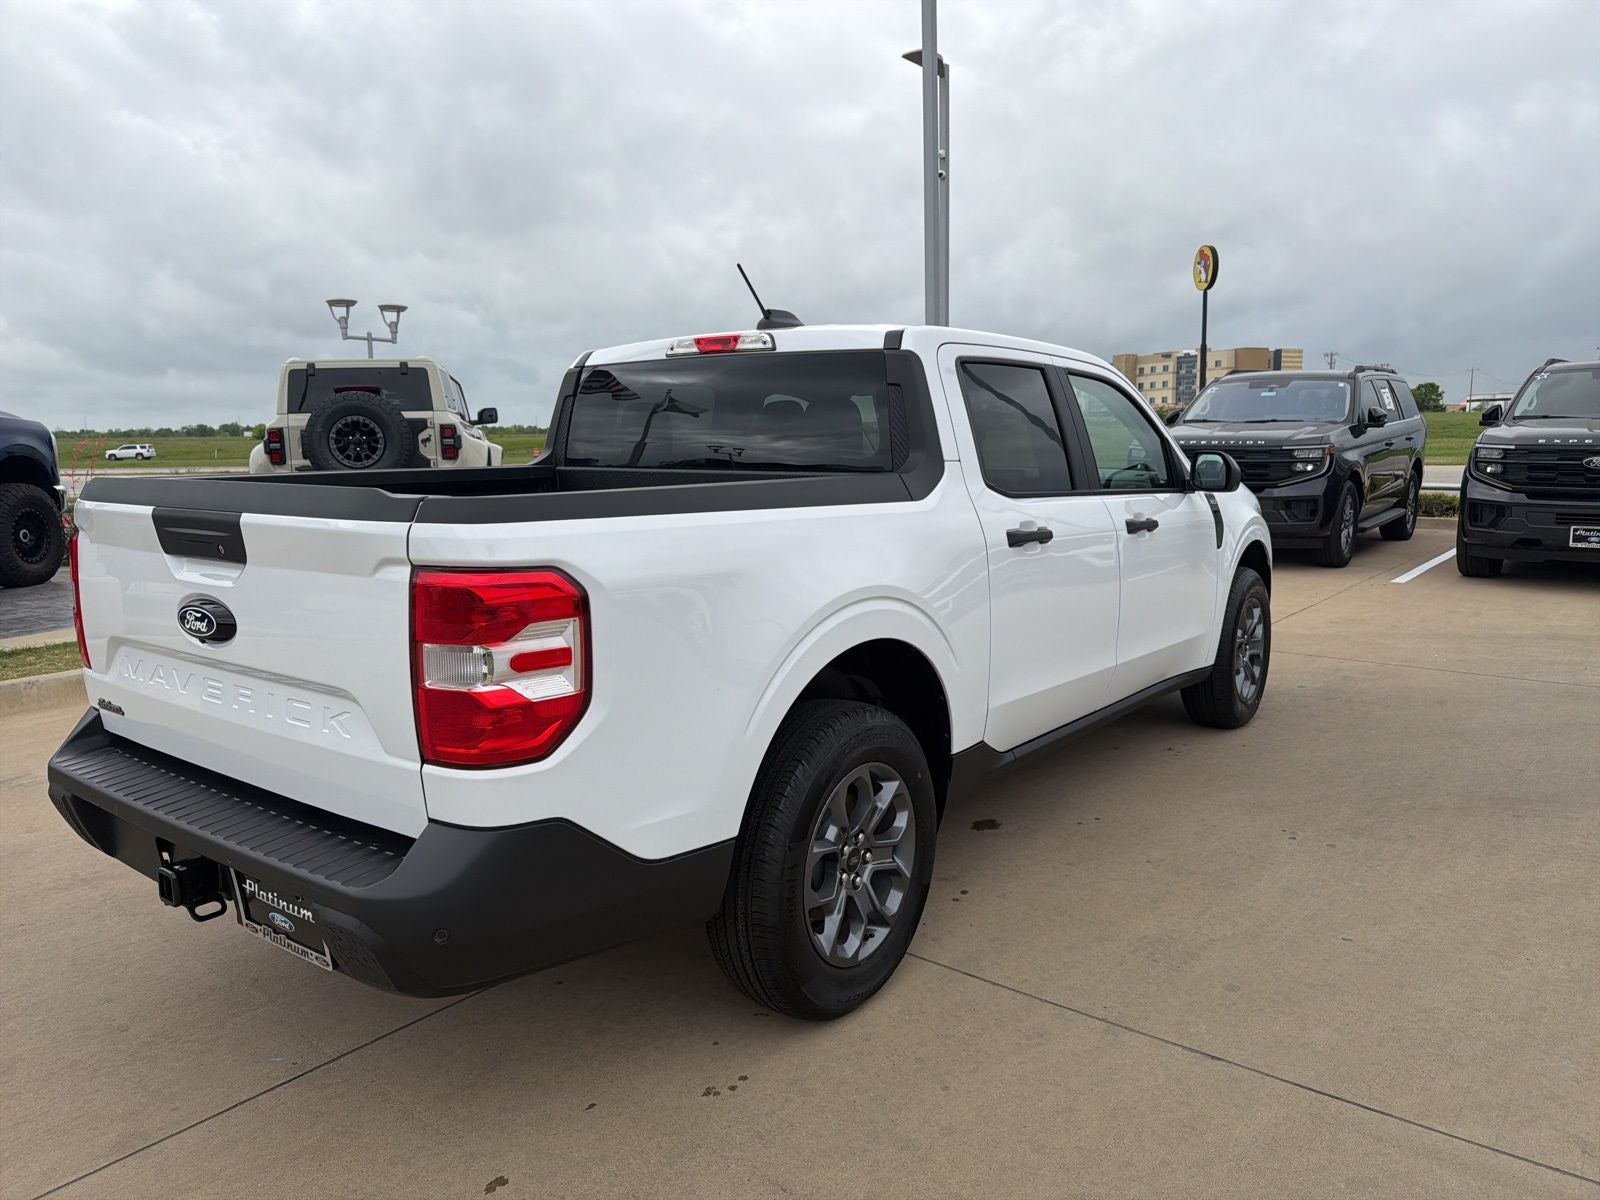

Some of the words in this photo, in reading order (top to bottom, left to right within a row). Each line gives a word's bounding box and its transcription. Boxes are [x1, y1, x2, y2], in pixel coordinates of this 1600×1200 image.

[184, 610, 208, 632] Ford
[122, 654, 352, 739] MAVERICK
[242, 879, 316, 924] Platinum
